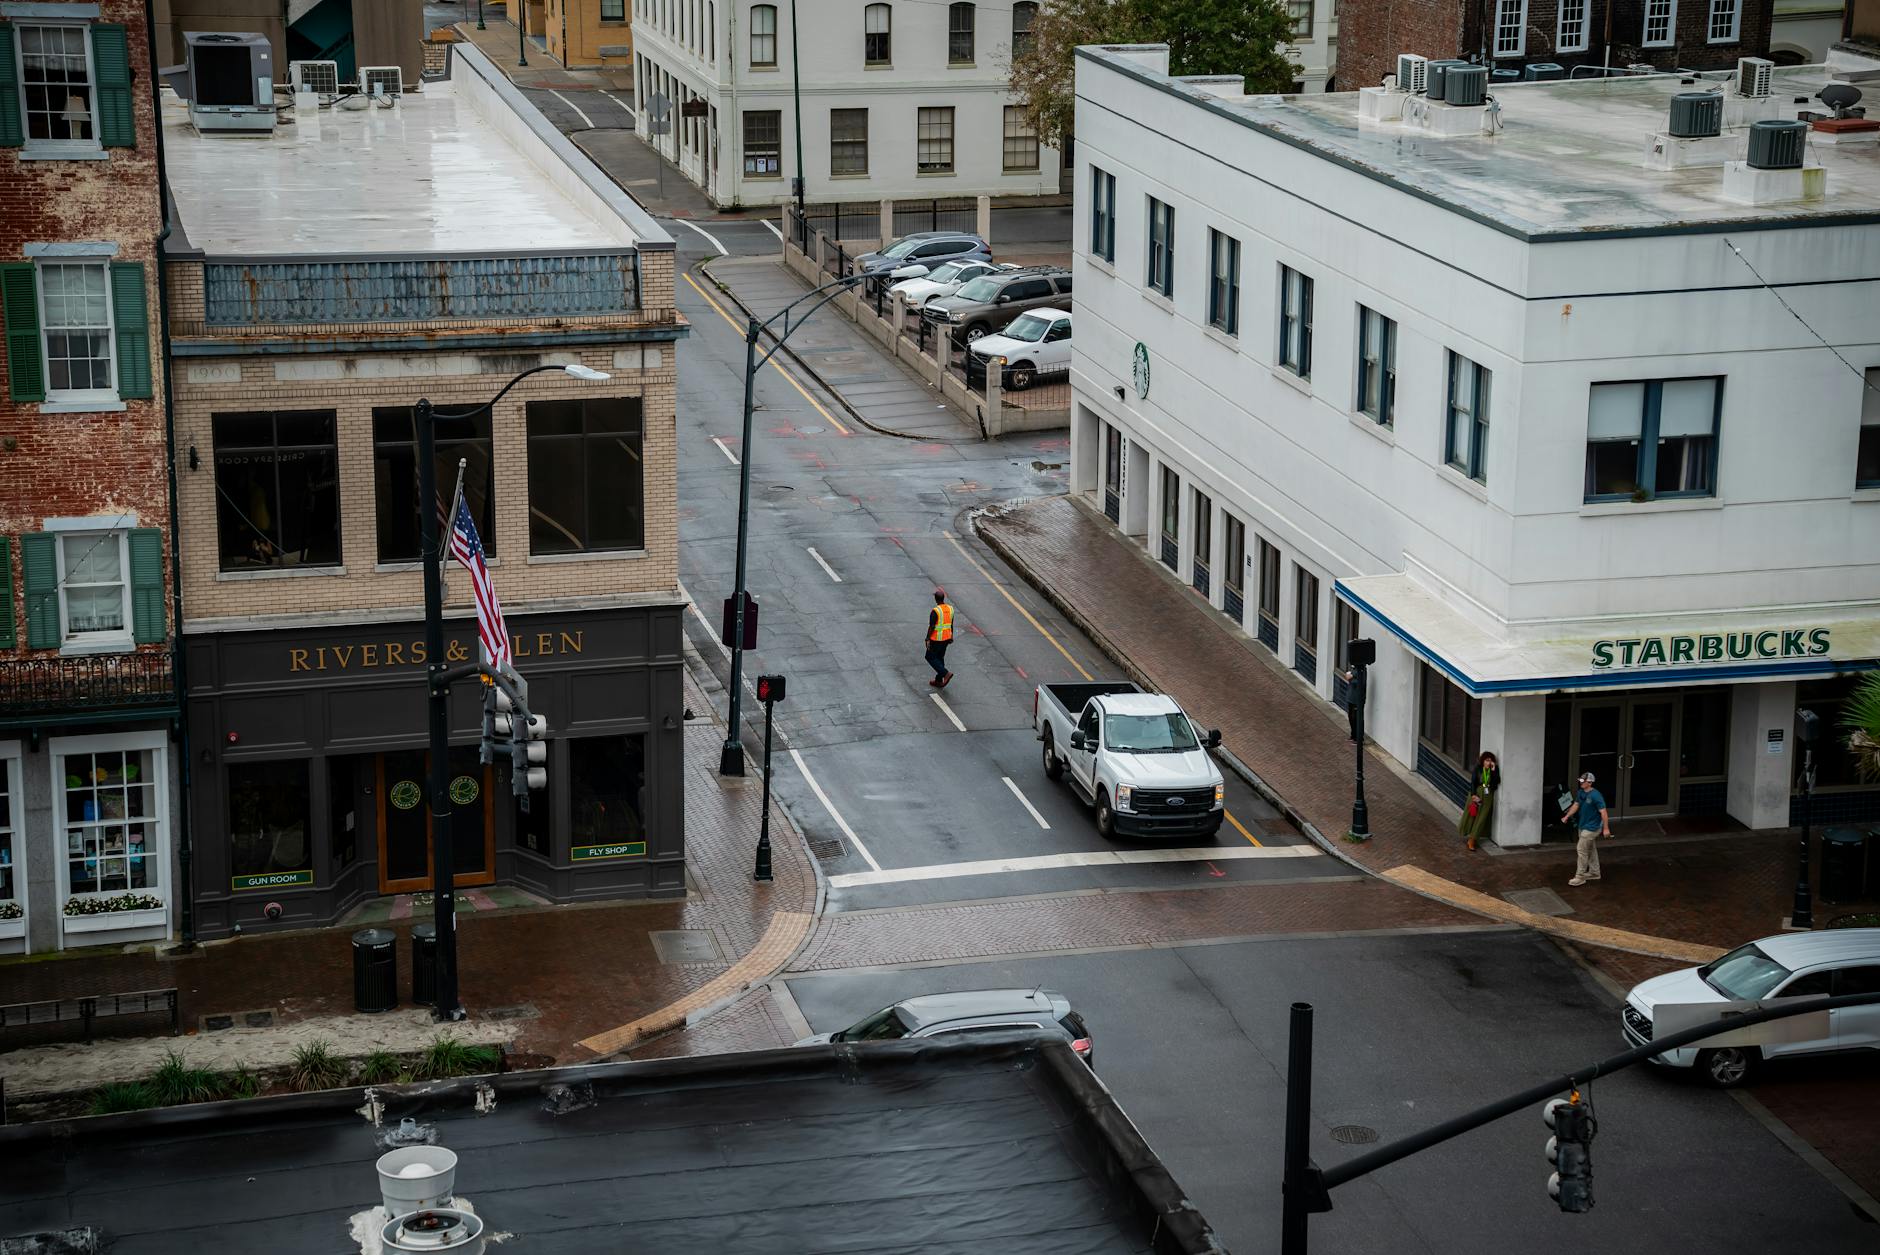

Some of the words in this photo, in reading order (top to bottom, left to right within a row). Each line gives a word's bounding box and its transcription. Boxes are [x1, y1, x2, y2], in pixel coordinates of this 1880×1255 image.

[289, 641, 427, 672] RIVERS
[446, 639, 470, 661] &
[500, 631, 584, 657] LEN
[1592, 628, 1831, 667] STARBUCKS
[589, 848, 604, 857] FLY
[605, 846, 628, 855] SHOP
[248, 877, 268, 886] GUN
[269, 875, 297, 884] ROOM
